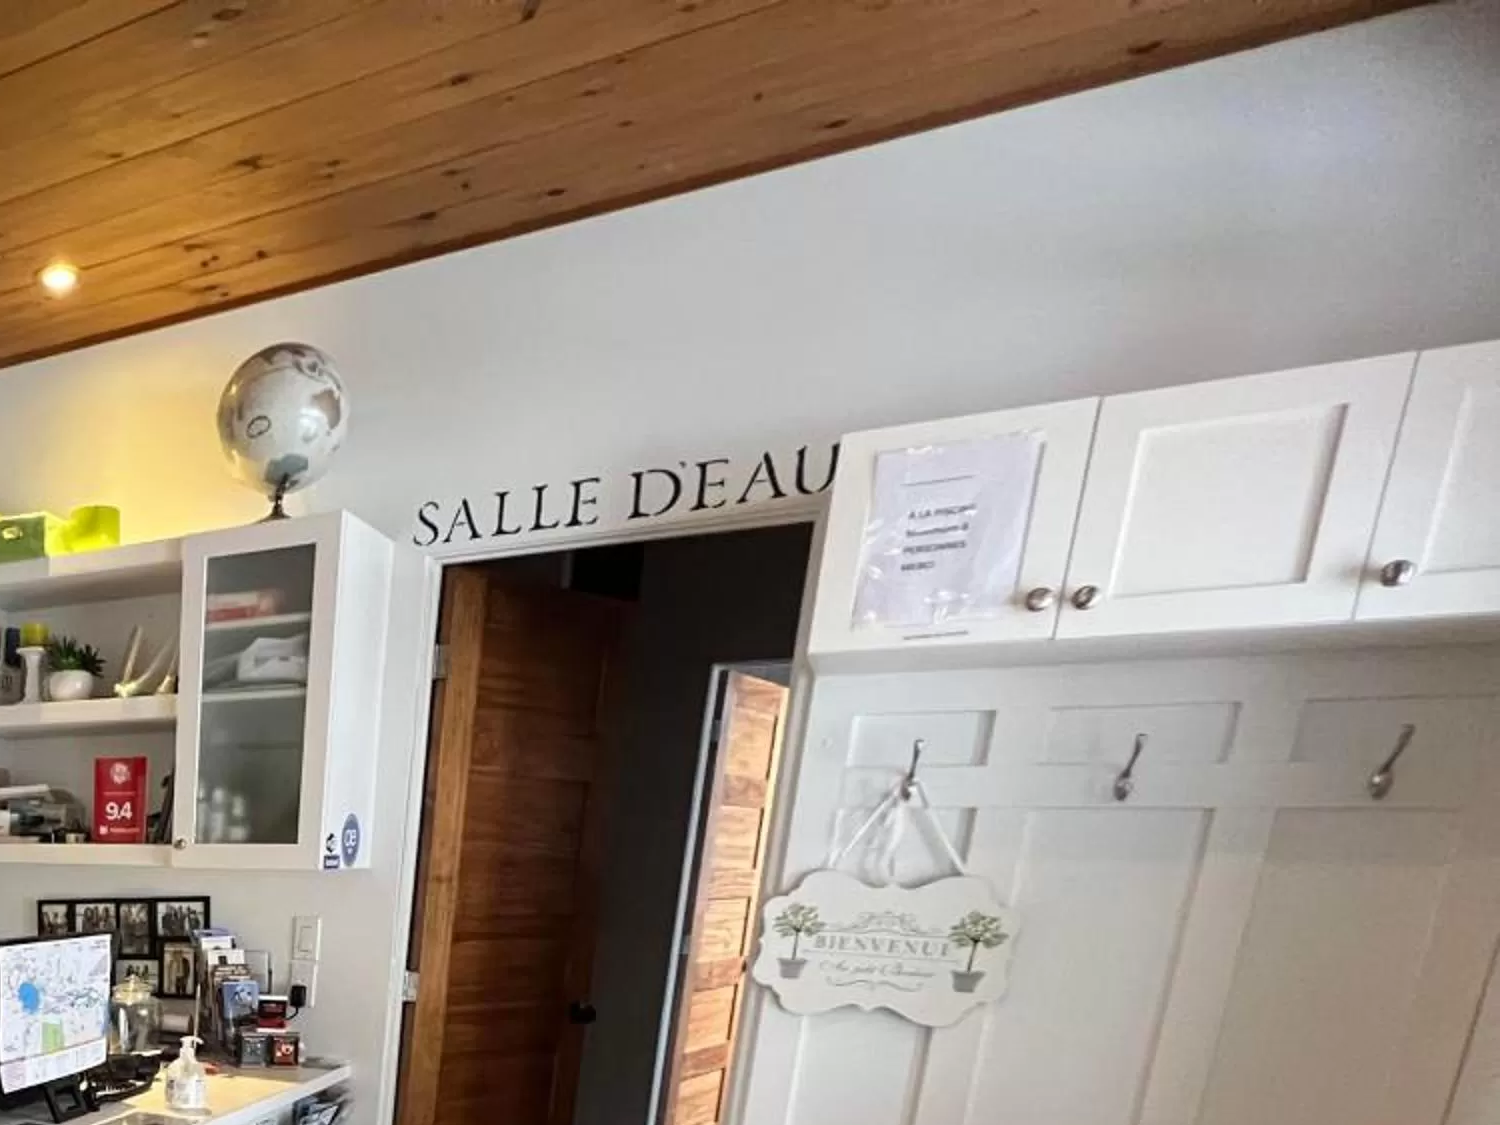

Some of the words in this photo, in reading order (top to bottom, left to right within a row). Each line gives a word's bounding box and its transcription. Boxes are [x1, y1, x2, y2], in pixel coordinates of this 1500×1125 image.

[412, 476, 601, 547] SALLE
[627, 441, 841, 520] D'EAU
[814, 934, 950, 958] BIENVENUE
